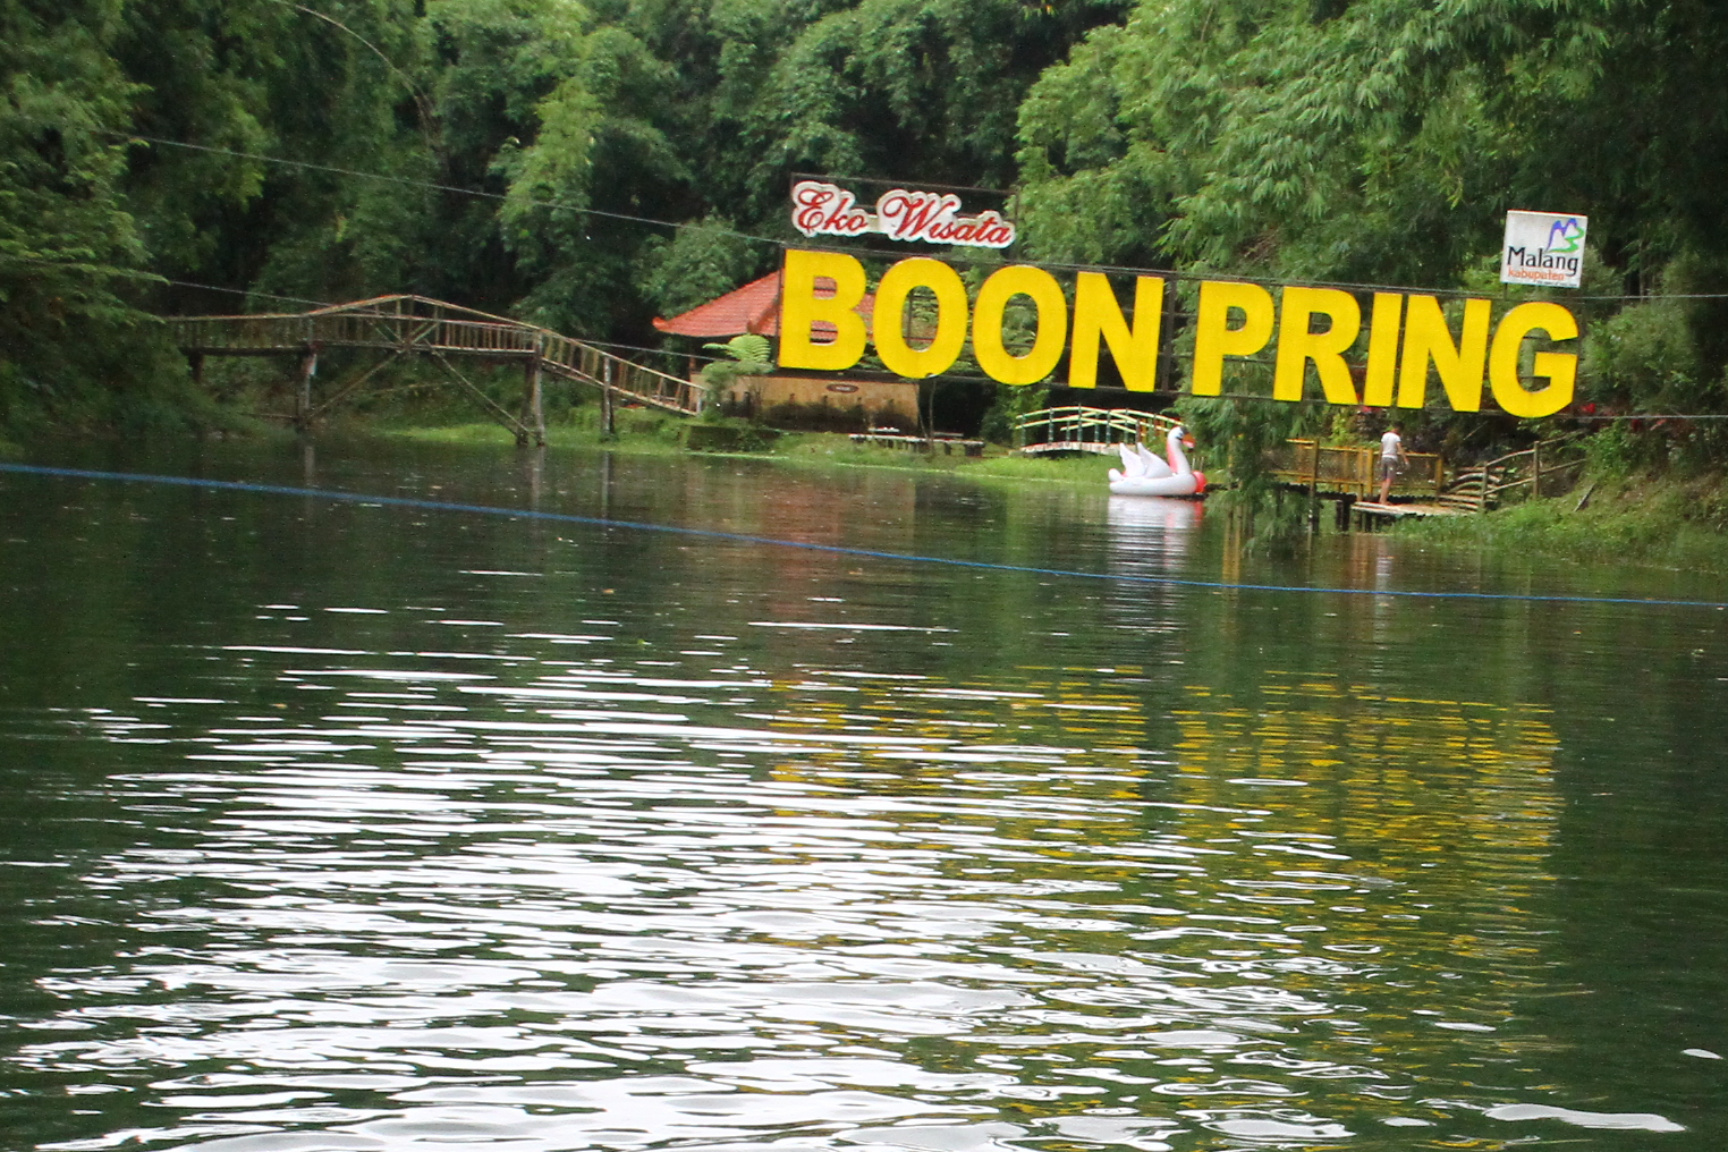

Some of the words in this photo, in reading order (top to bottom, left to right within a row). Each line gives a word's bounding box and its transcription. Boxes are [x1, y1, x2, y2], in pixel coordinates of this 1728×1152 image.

[798, 188, 868, 233] Eko
[883, 196, 1012, 243] Wisata
[1507, 246, 1579, 277] Malang
[777, 248, 1166, 393] BOON
[1190, 281, 1580, 419] PRING
